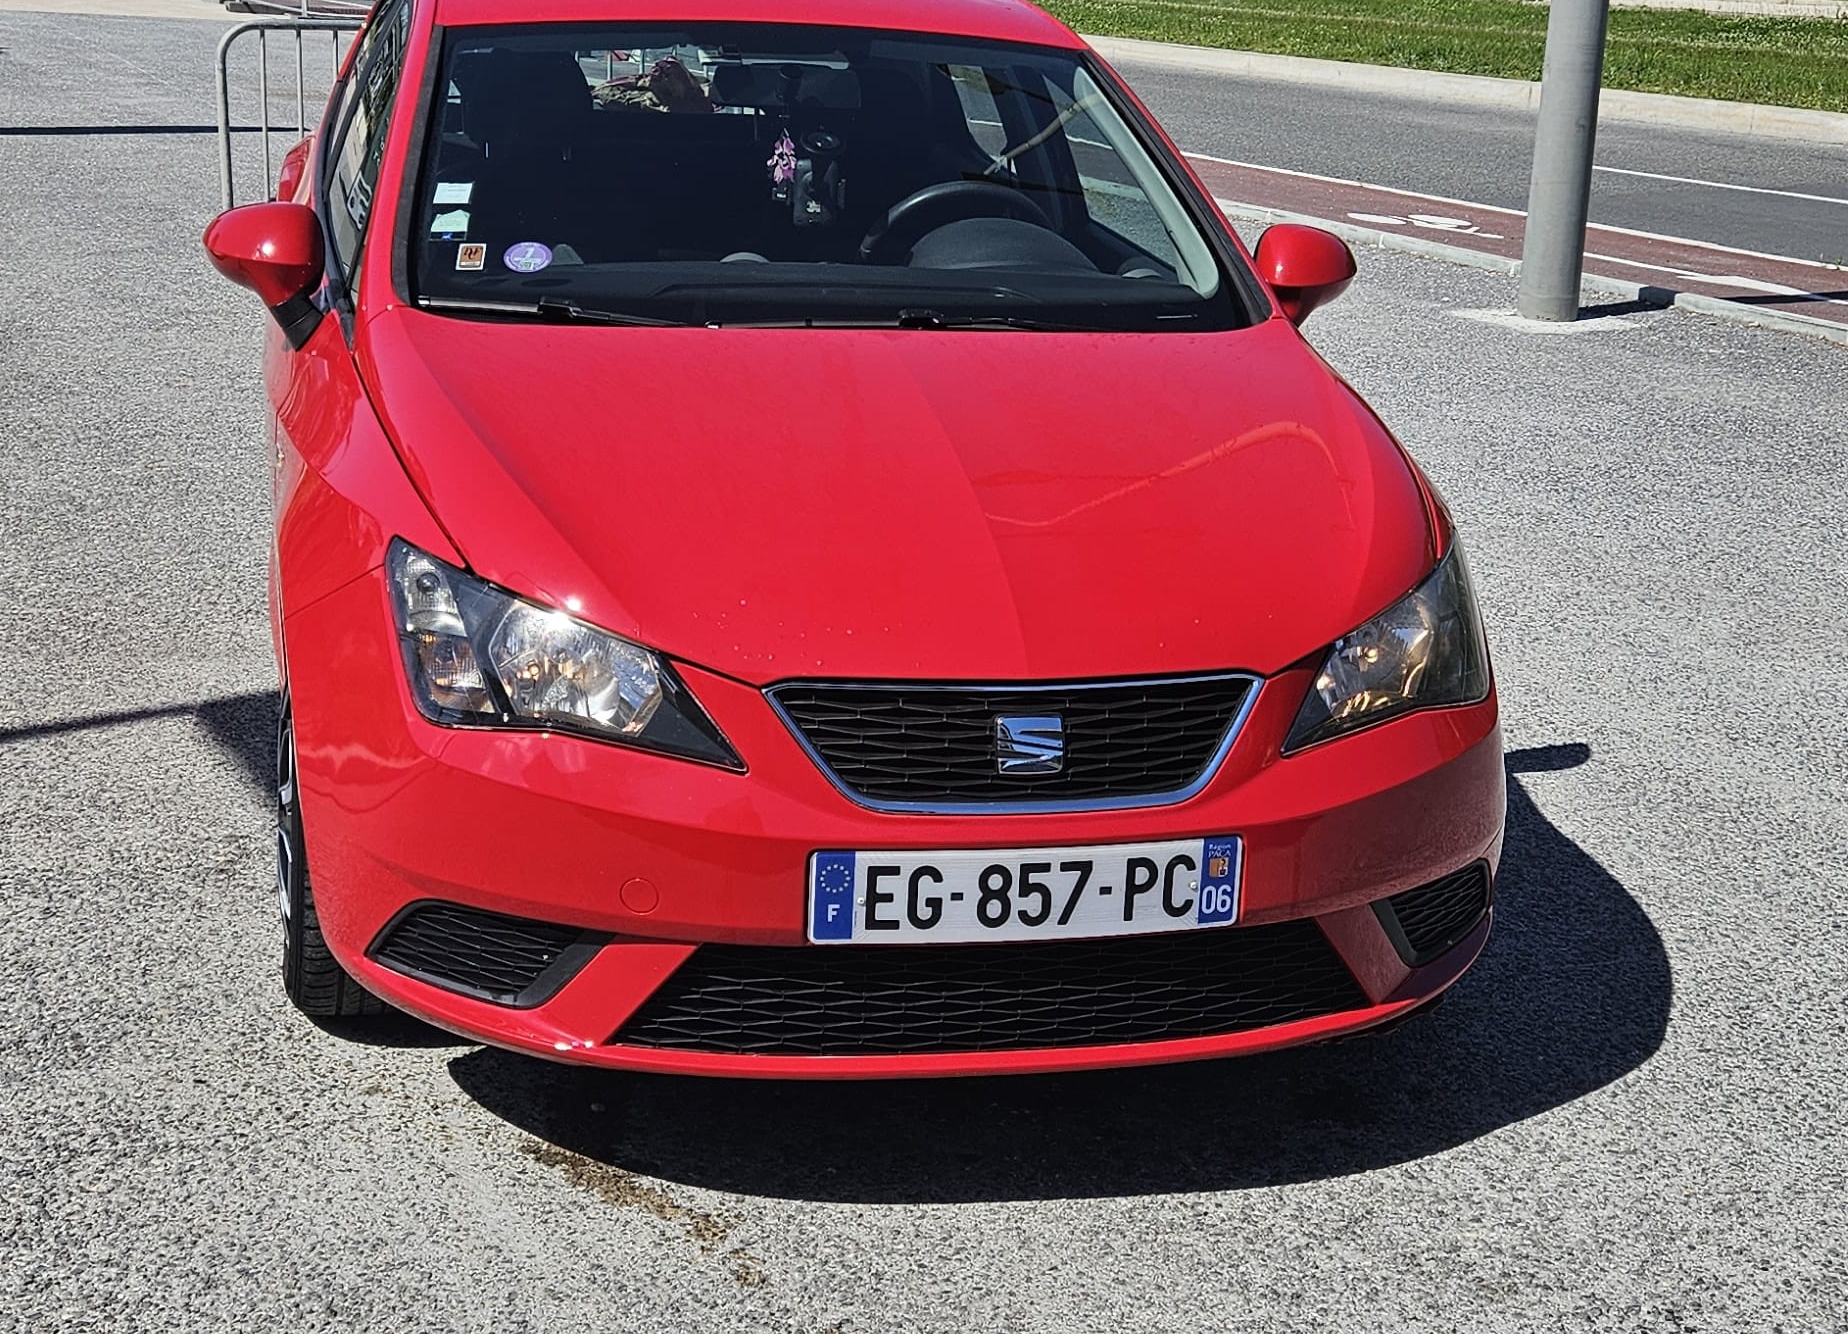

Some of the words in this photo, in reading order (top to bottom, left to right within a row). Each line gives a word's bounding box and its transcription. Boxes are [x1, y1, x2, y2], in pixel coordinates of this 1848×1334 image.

[1208, 849, 1231, 858] PACA
[864, 854, 1196, 931] EG-857-PC
[1201, 884, 1232, 914] 06
[827, 904, 840, 922] F
